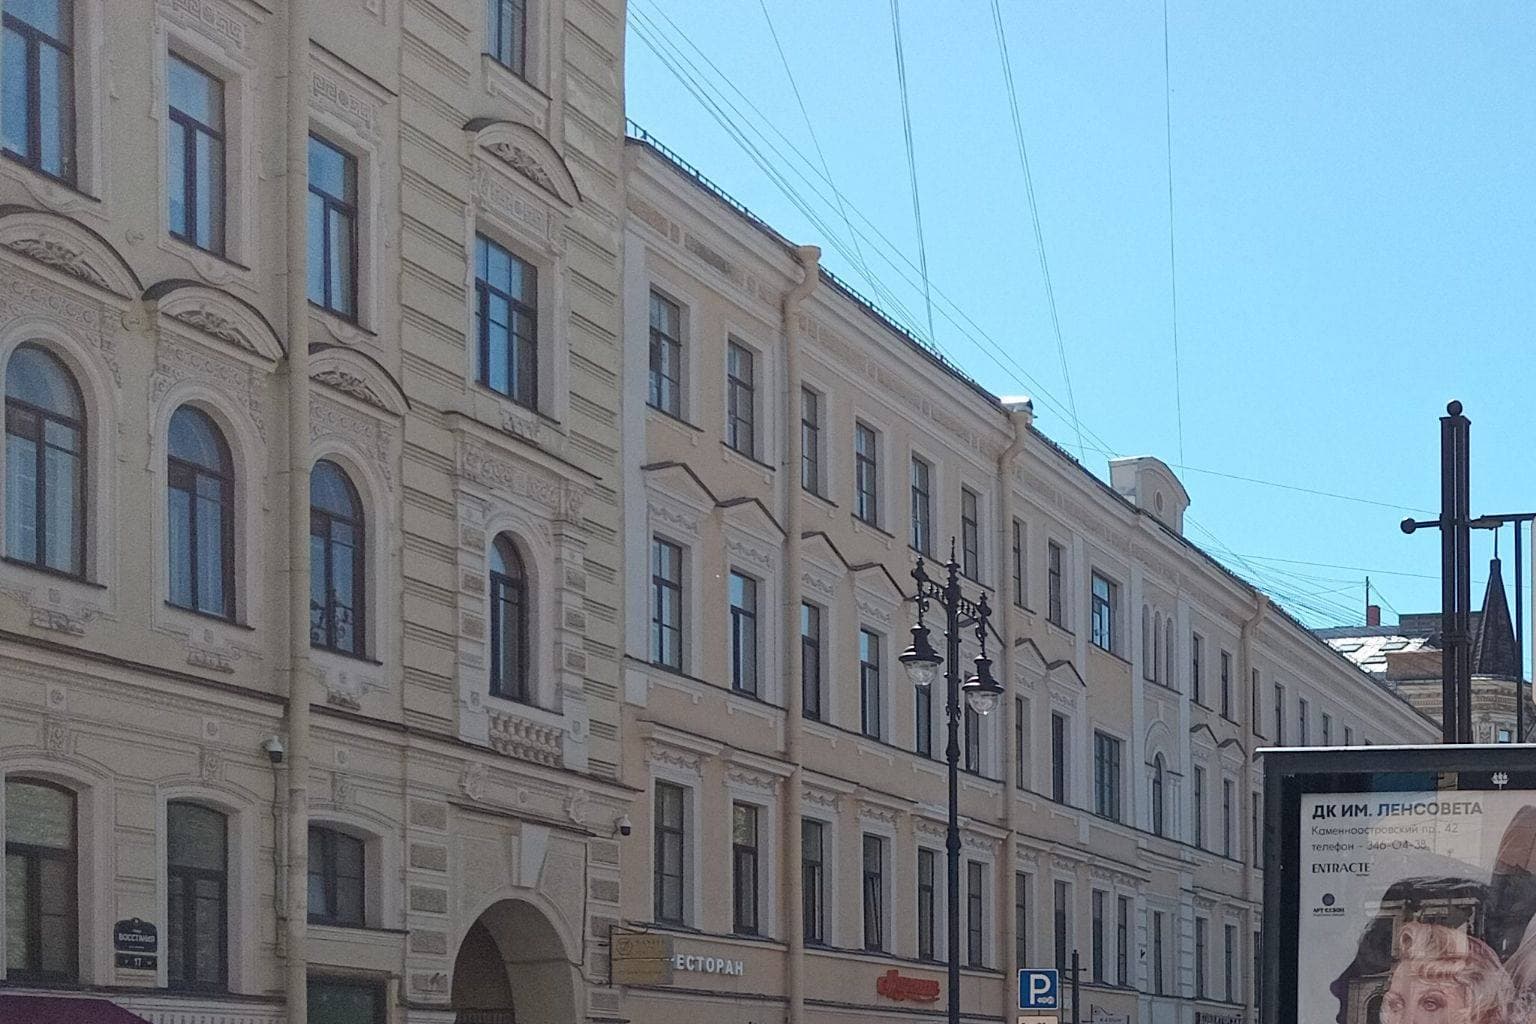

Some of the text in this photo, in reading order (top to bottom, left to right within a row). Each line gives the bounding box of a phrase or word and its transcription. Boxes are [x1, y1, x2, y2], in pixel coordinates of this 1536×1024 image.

[1312, 802, 1483, 820] ДК ИМ. ЛЕНСОВЕТА
[1312, 823, 1418, 836] Каменноостровский
[1444, 824, 1458, 833] 42
[1312, 841, 1354, 853] телефон
[1312, 862, 1370, 874] ENTRACTE
[118, 932, 156, 943] ВОССТАНИЯ
[671, 953, 744, 976] ЕСТОРАН
[1030, 974, 1051, 1005] P
